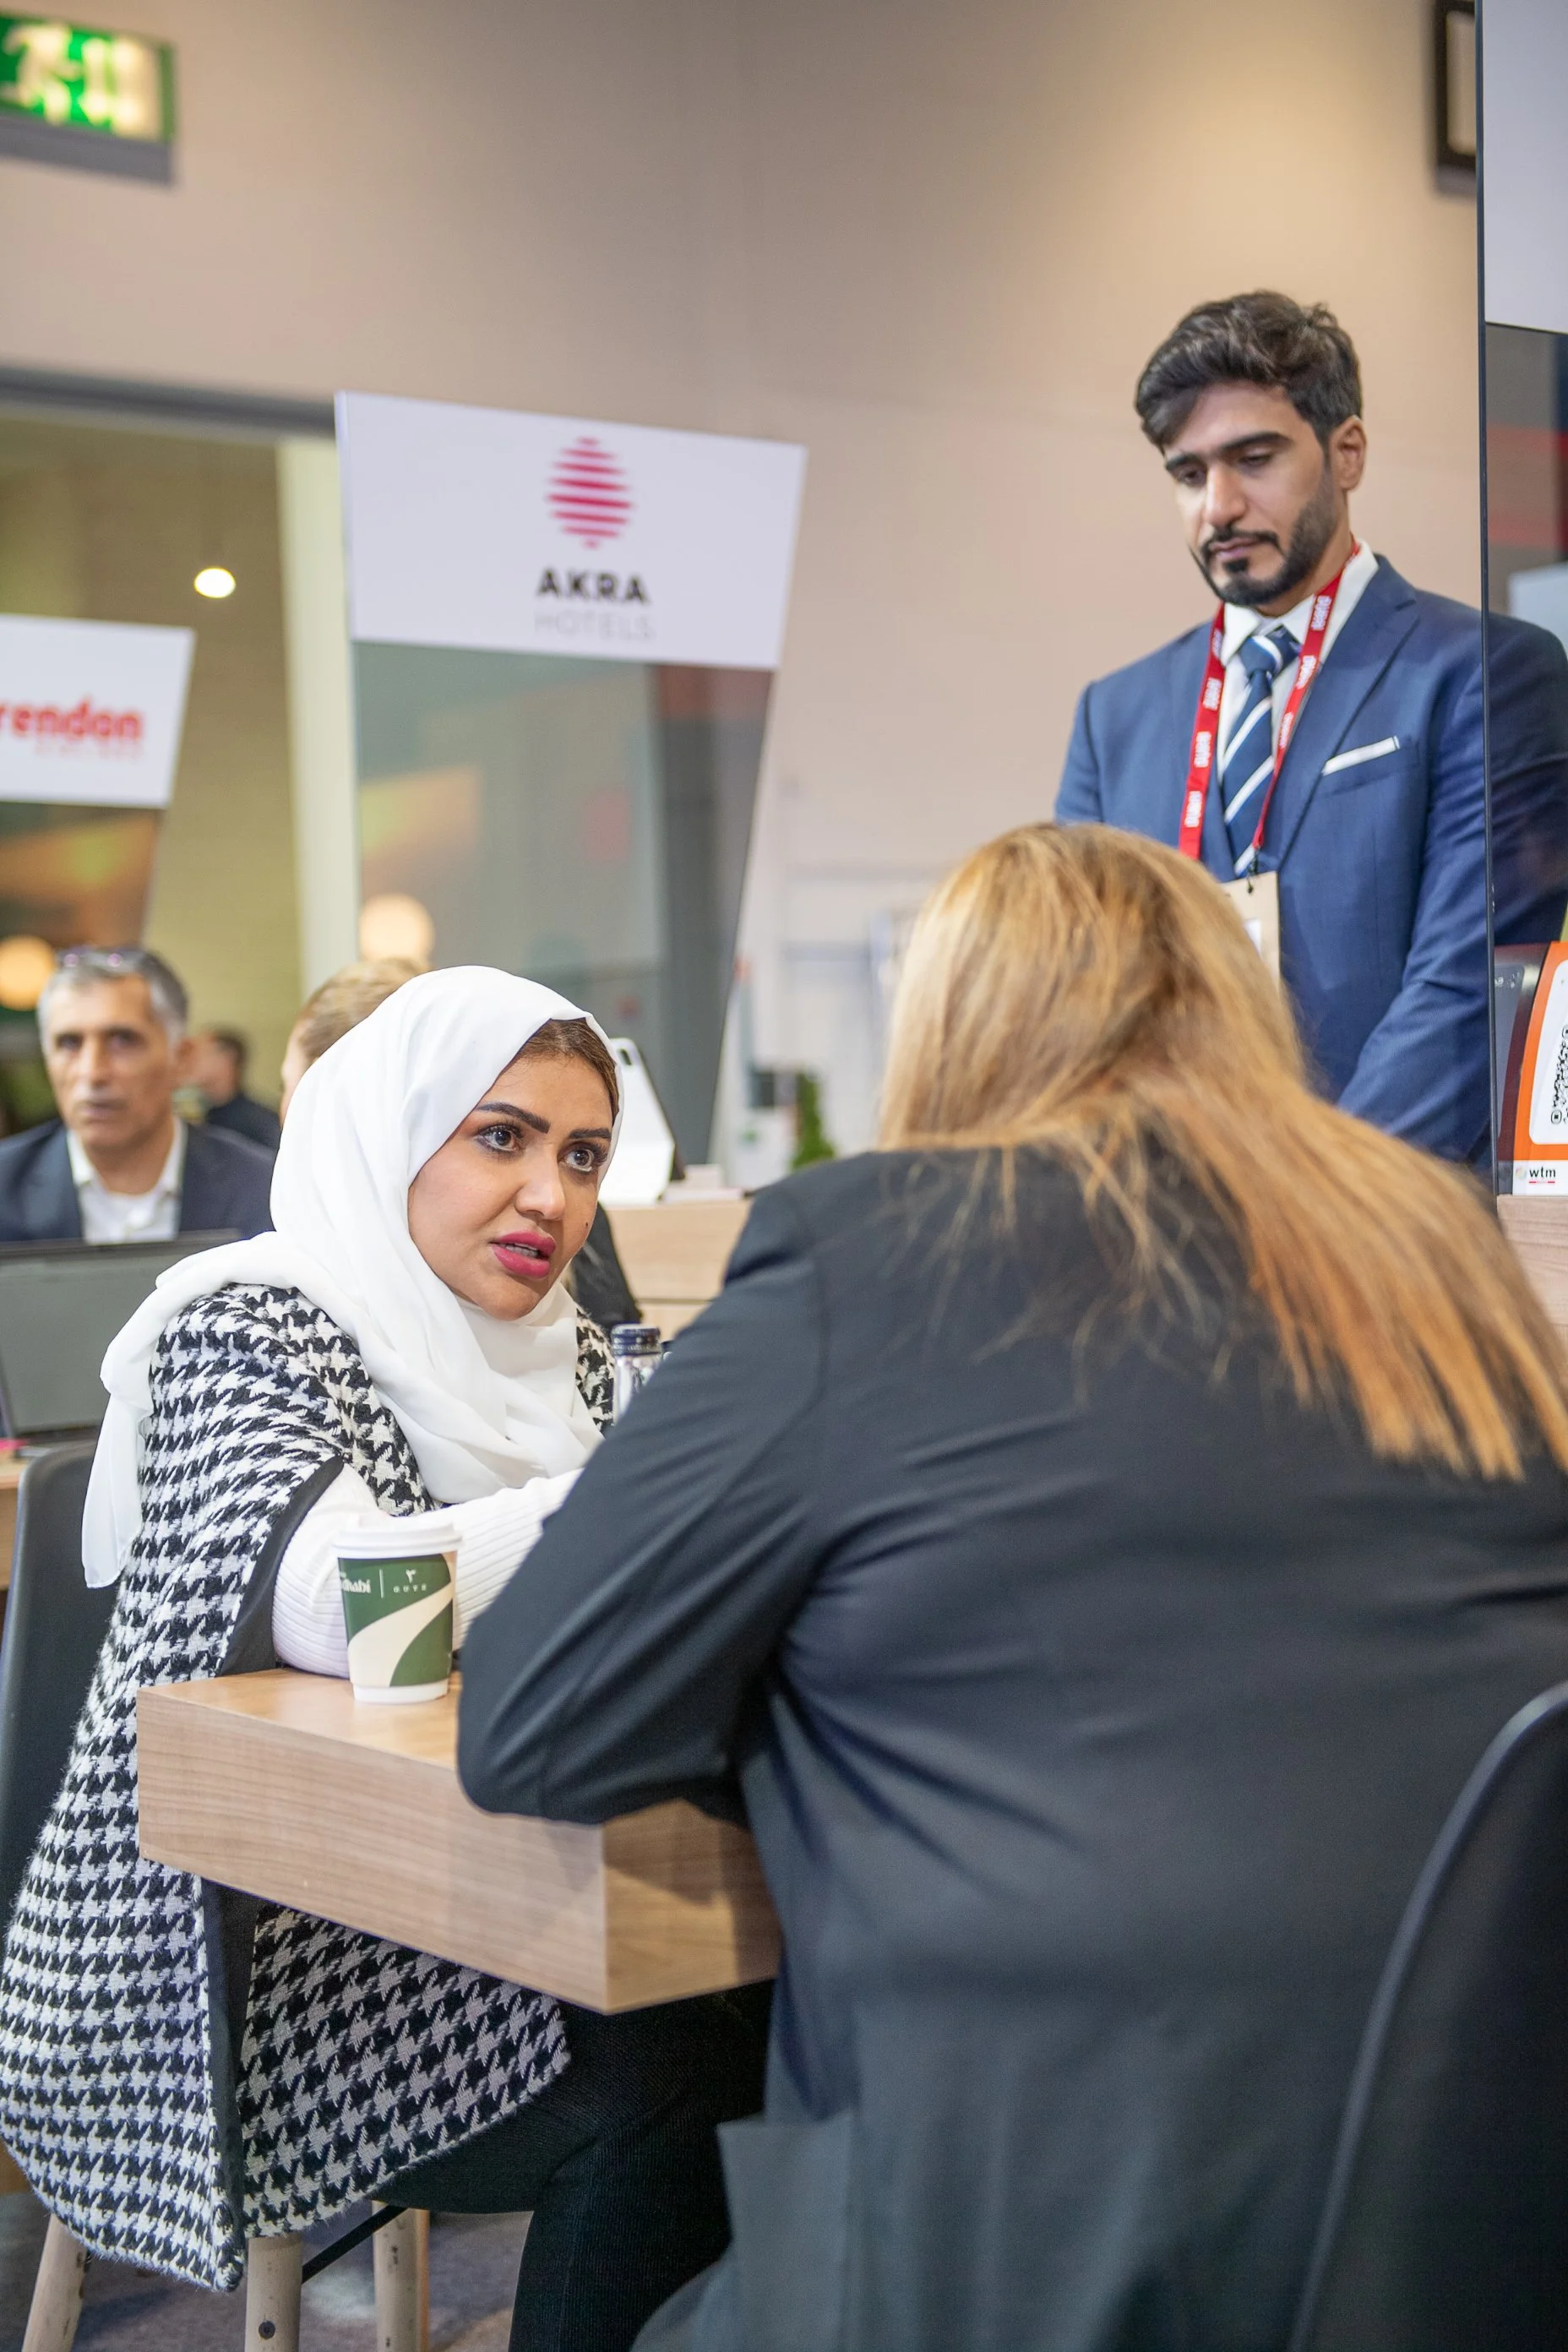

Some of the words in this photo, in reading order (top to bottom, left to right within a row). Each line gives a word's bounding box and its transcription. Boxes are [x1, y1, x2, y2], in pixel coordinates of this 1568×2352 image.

[535, 567, 653, 607] AKRA
[533, 609, 656, 643] HOTELS
[1529, 1165, 1556, 1178] wtm
